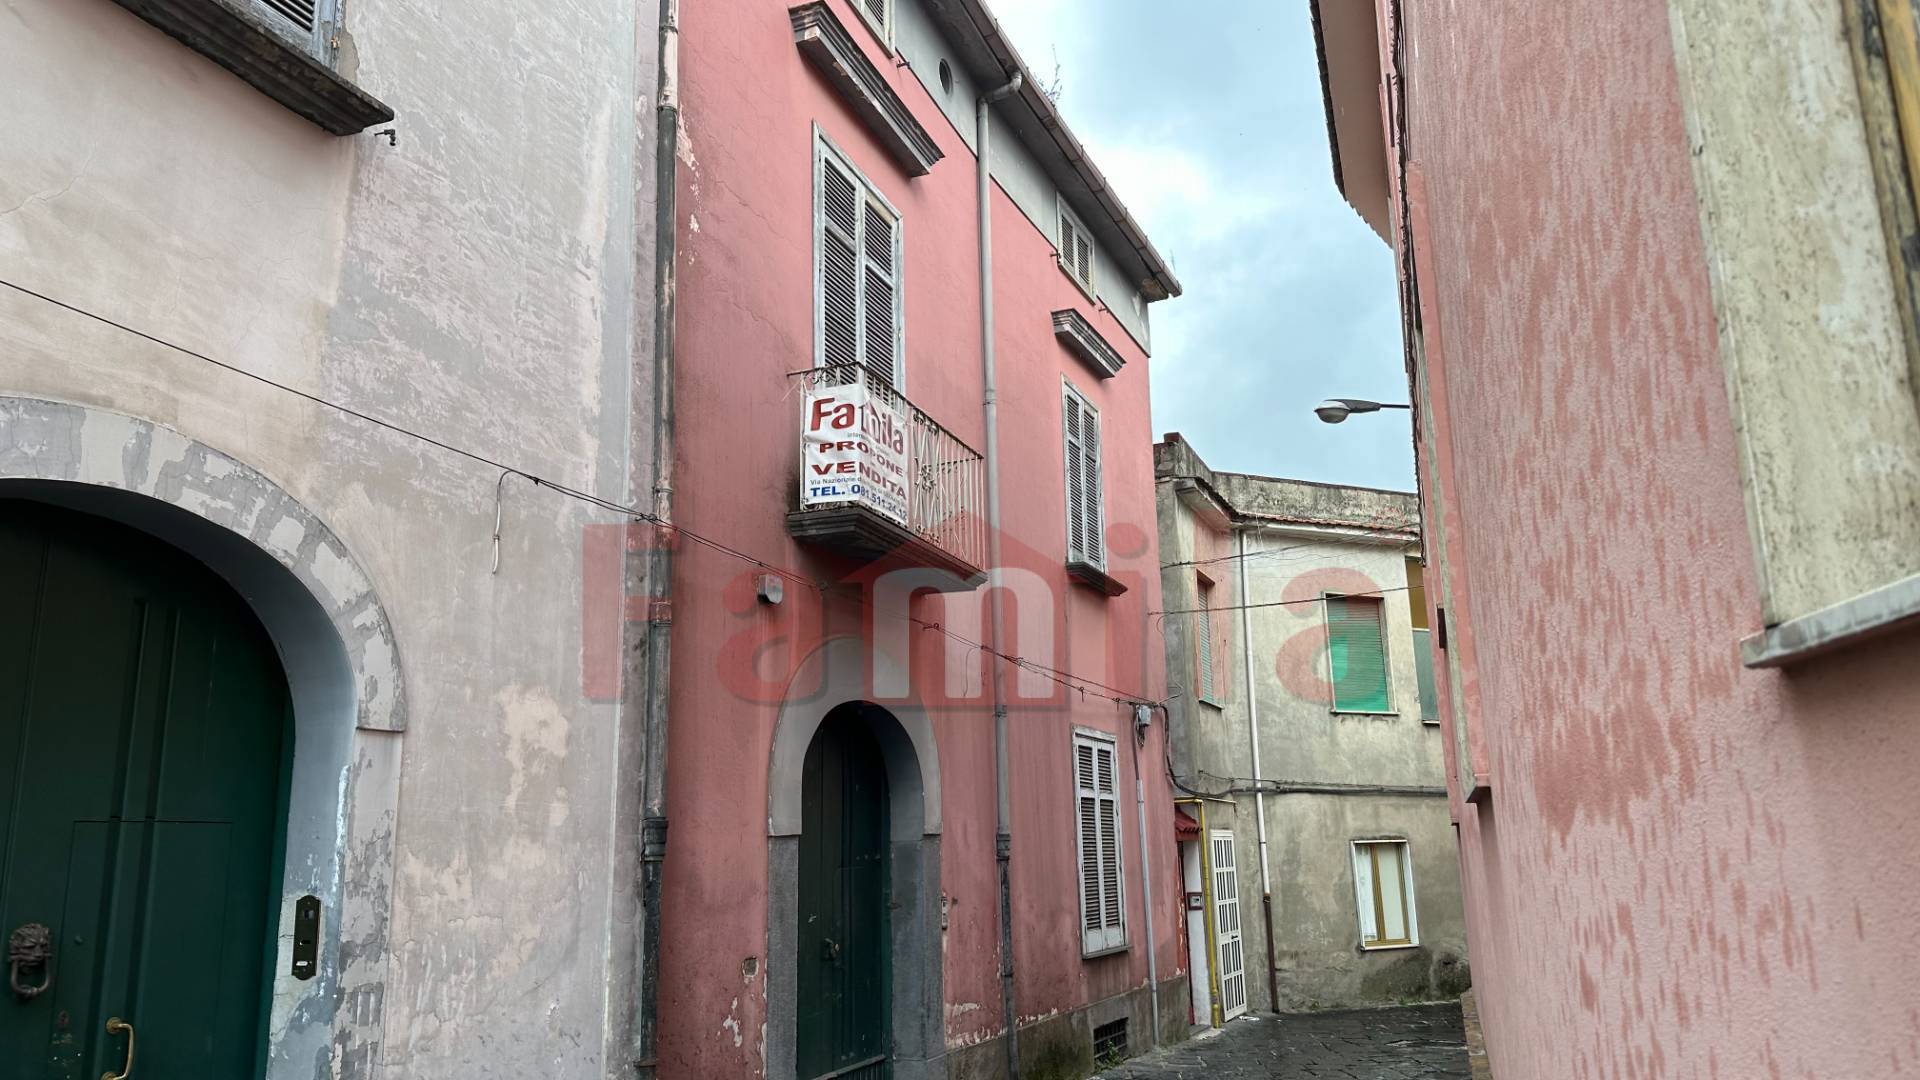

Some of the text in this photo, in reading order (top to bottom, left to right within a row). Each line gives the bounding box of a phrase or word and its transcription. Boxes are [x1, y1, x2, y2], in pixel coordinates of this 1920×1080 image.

[811, 398, 903, 454] Famila
[819, 441, 903, 477] PROPONE
[810, 486, 845, 497] TEL.
[811, 461, 906, 499] VENDITA
